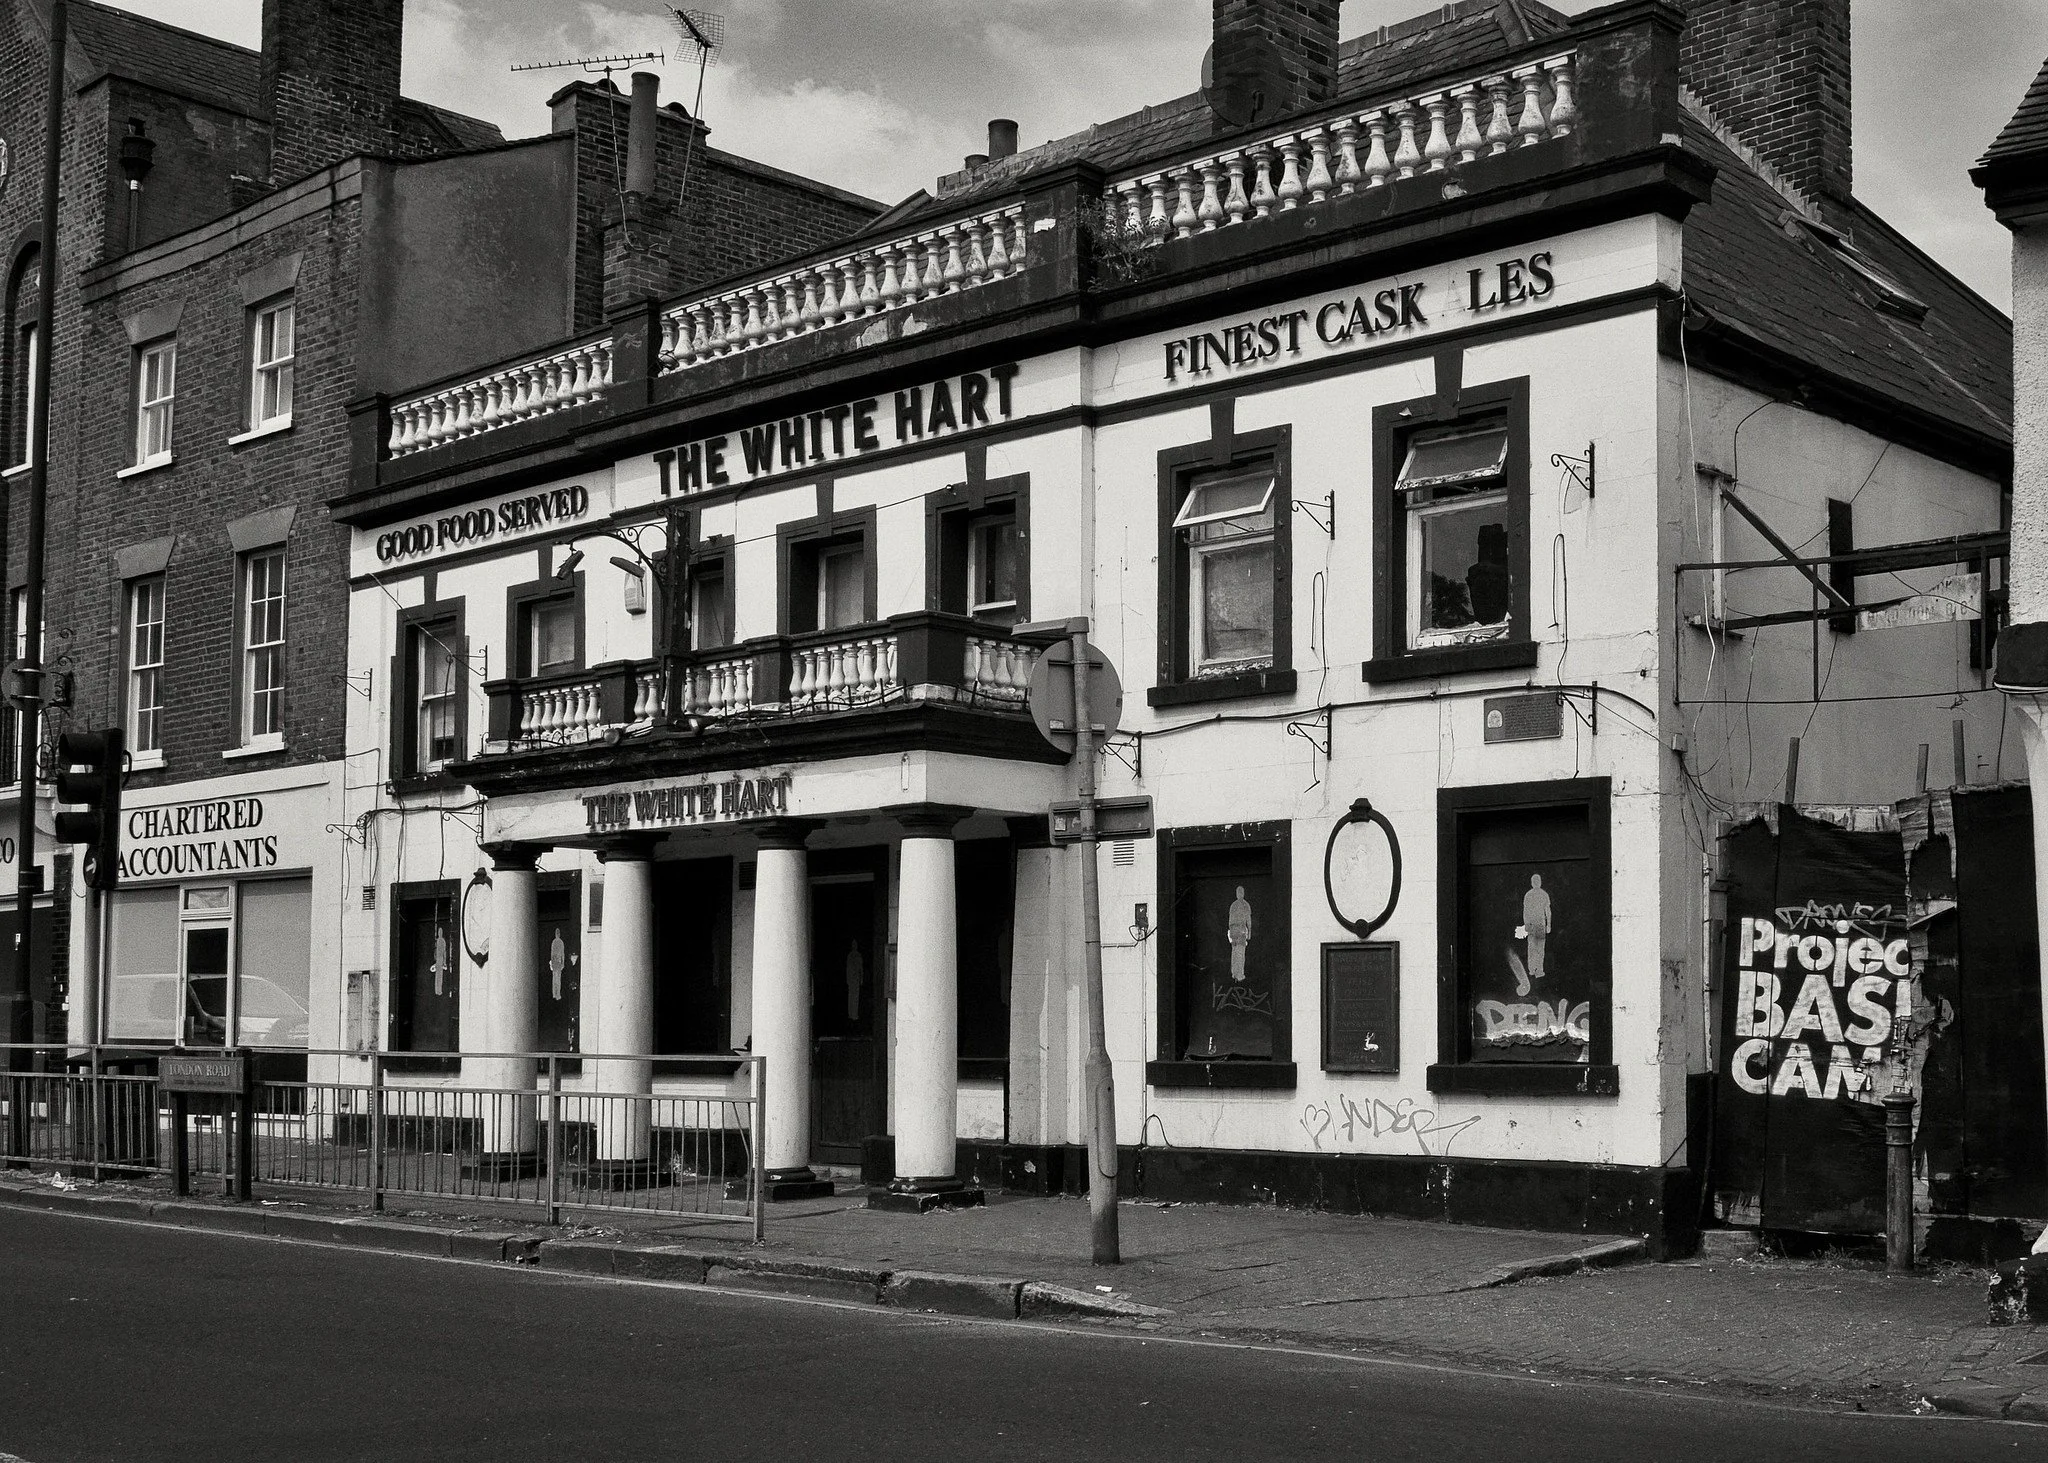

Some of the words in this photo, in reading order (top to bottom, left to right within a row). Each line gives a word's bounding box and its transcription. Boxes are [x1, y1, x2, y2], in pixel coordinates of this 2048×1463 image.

[1163, 308, 1307, 380] FINEST
[1315, 282, 1428, 343] CASK
[1466, 250, 1554, 312] LES
[653, 436, 730, 495] THE
[740, 398, 879, 475] WHITE
[894, 362, 1019, 440] HART
[376, 523, 434, 562] GOOD
[435, 507, 496, 548] FOOD
[498, 485, 590, 532] SERVED
[128, 798, 264, 840] CHARTERED
[581, 792, 631, 831] THE
[632, 782, 717, 823] WHITE
[719, 775, 793, 815] HART
[0, 837, 15, 864] O
[118, 834, 278, 878] ACCOUNTANTS
[169, 1064, 203, 1076] LONDON
[206, 1064, 231, 1077] ROAD
